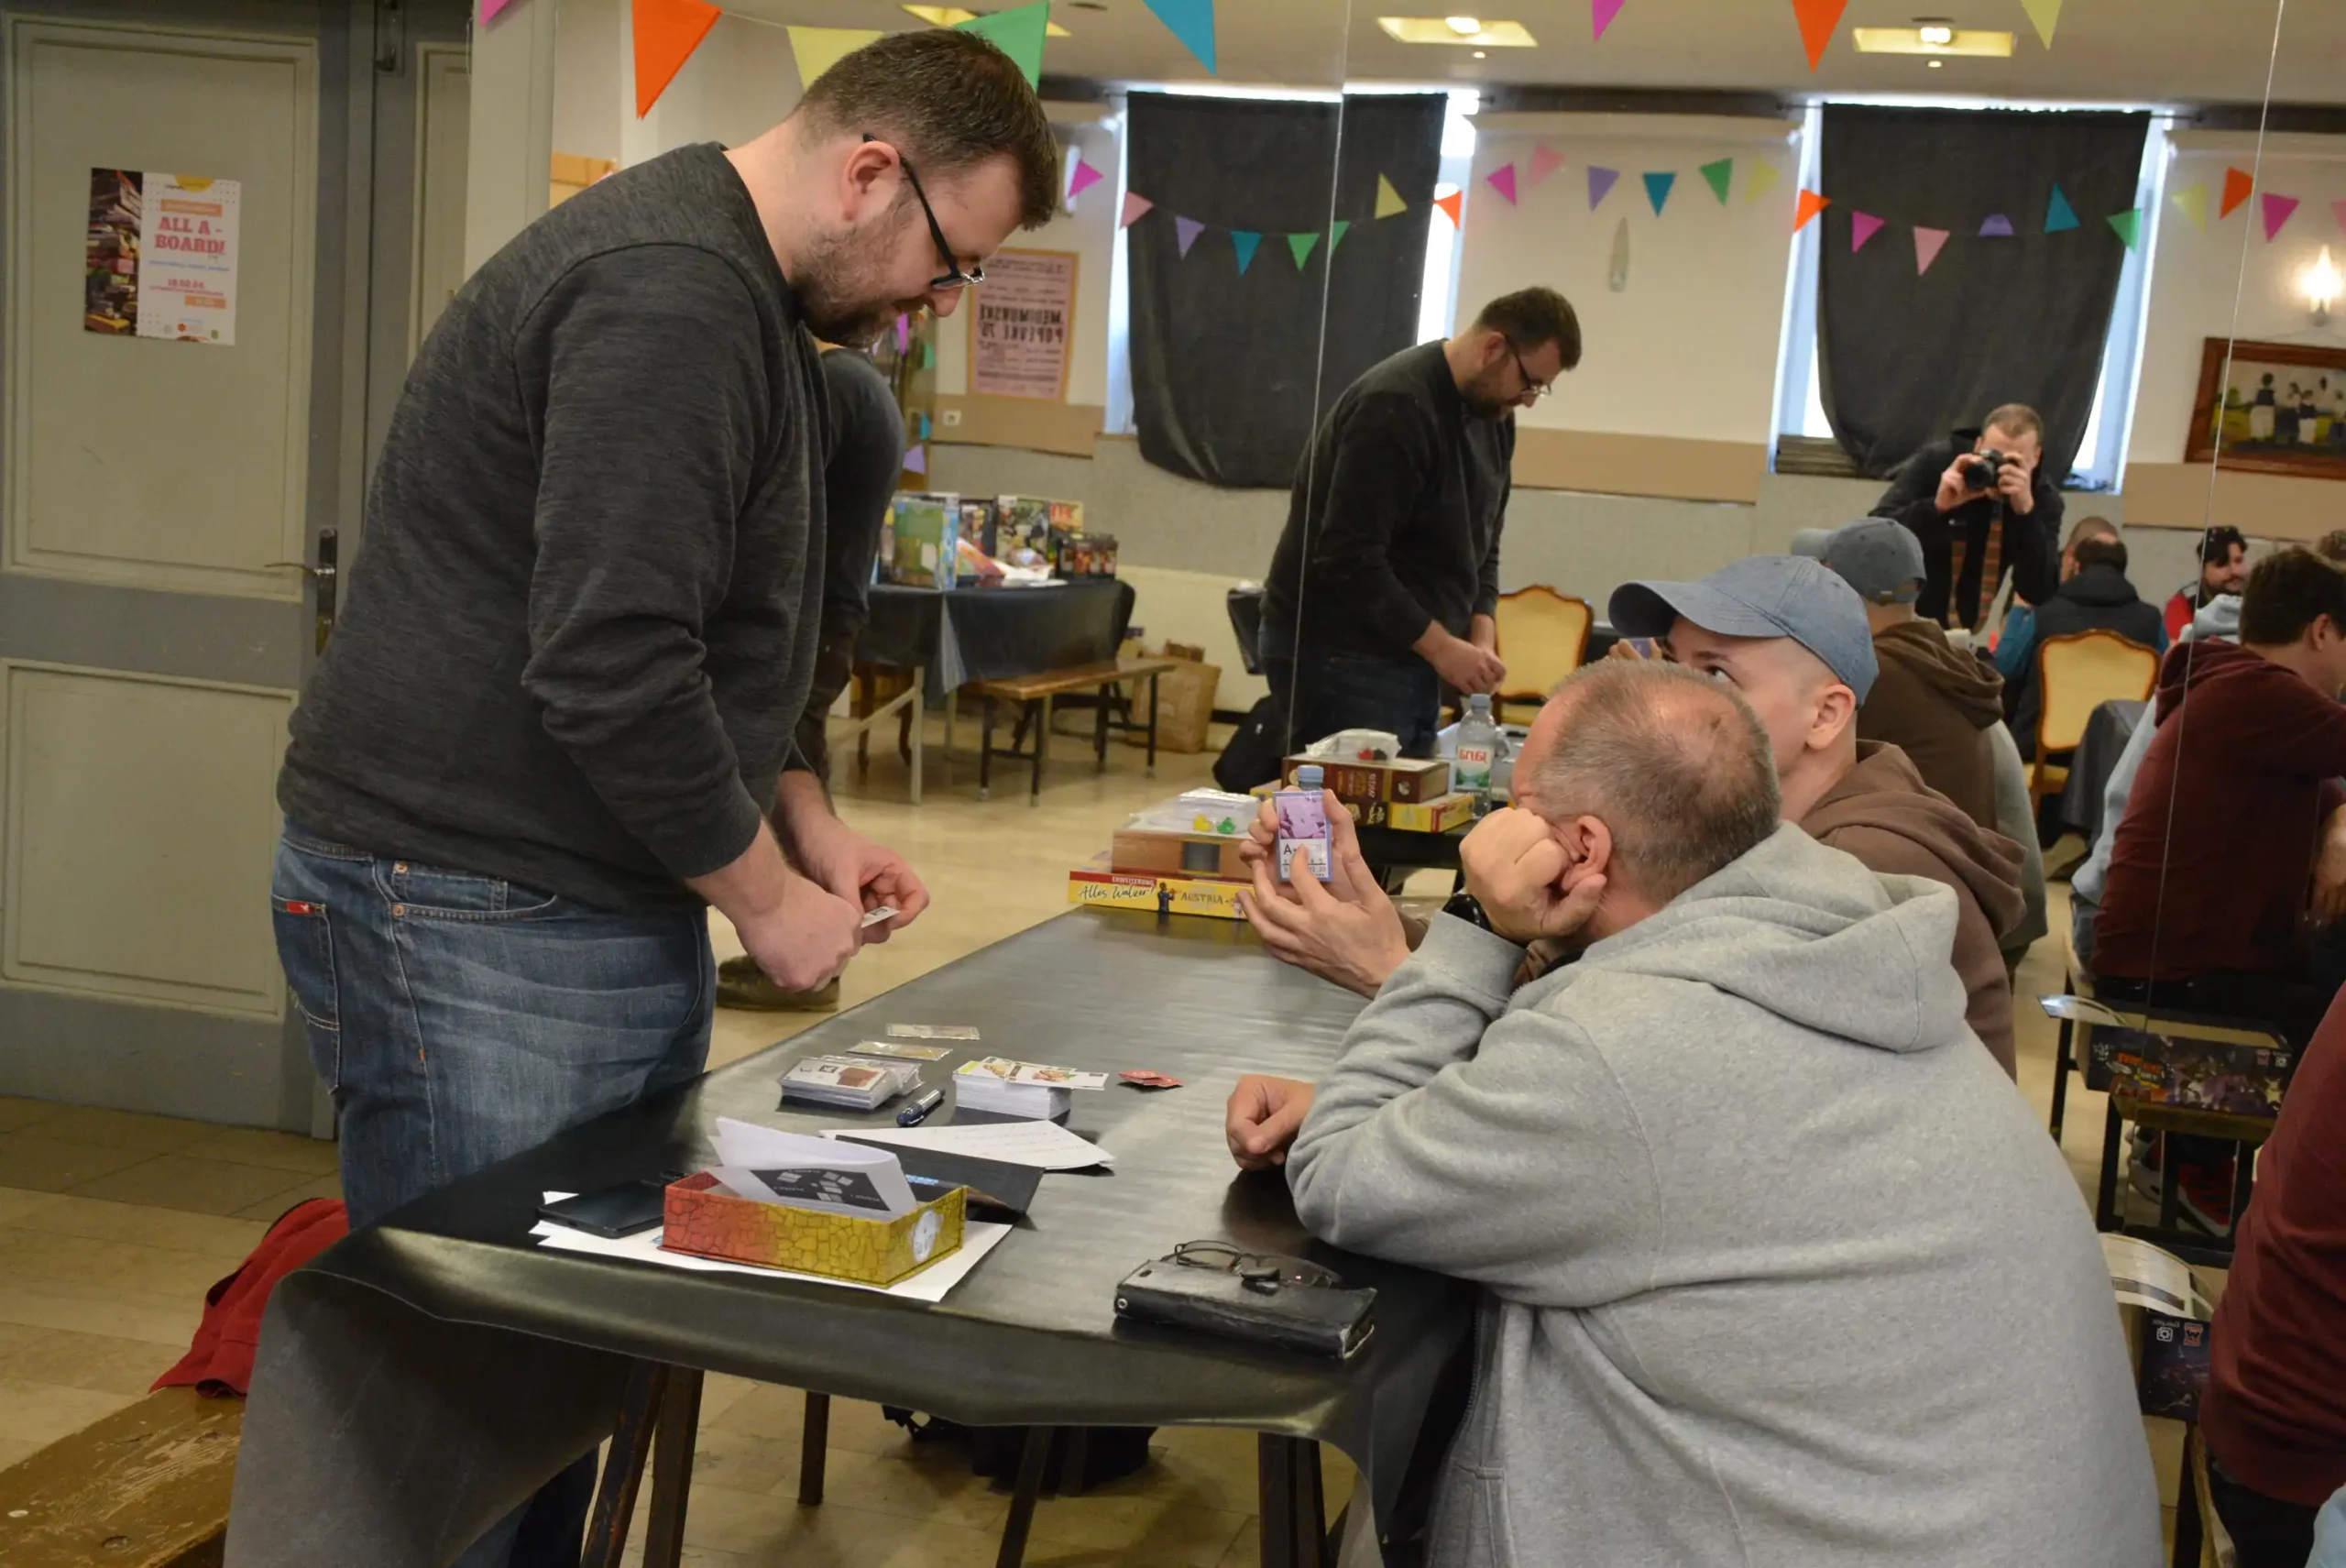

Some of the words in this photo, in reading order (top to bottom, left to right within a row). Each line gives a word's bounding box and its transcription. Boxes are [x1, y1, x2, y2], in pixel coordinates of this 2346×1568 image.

[159, 216, 192, 232] ALL
[197, 220, 211, 236] A
[154, 234, 226, 255] BOARD!
[1283, 843, 1292, 854] A
[1079, 883, 1107, 900] Alles
[1179, 891, 1223, 905] AUSTRIA
